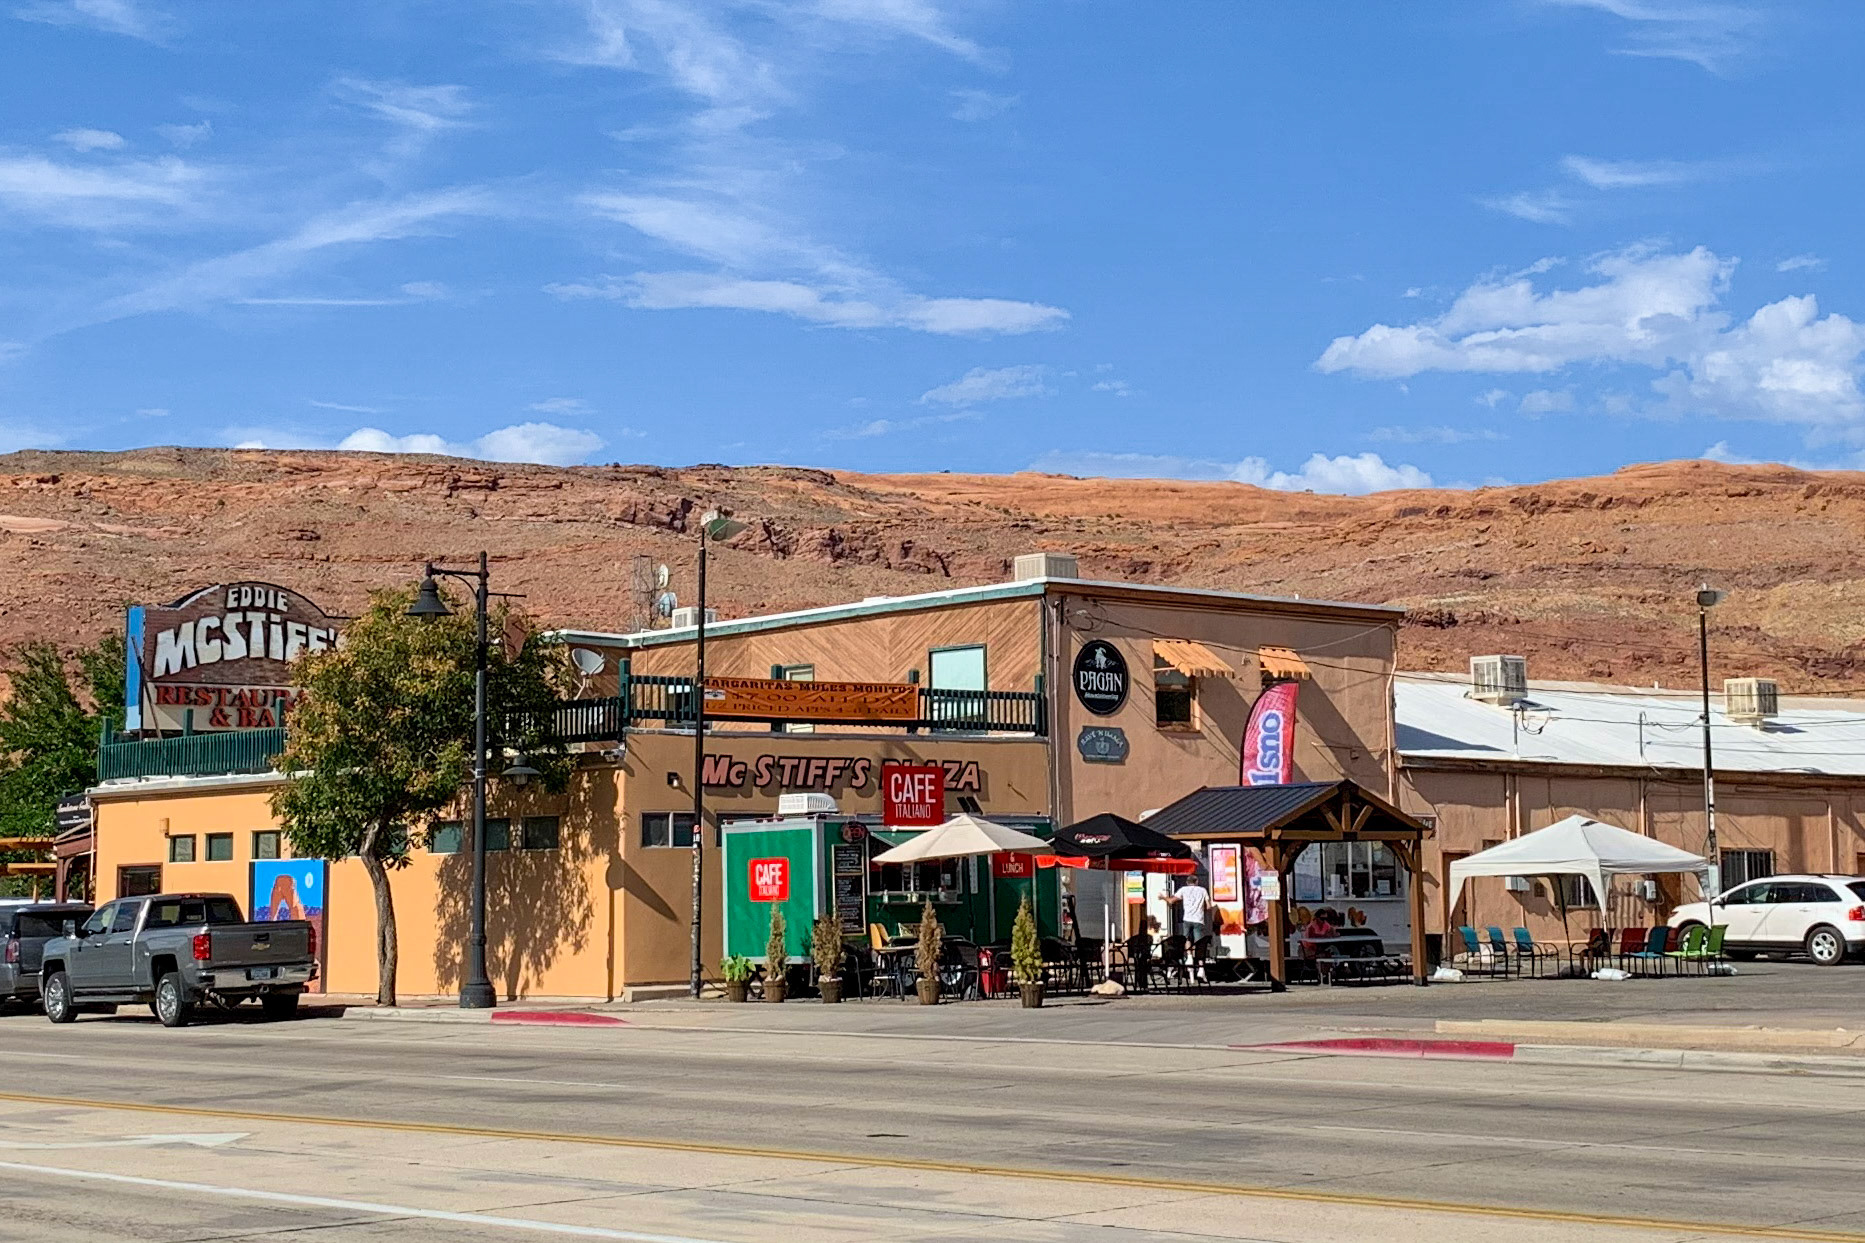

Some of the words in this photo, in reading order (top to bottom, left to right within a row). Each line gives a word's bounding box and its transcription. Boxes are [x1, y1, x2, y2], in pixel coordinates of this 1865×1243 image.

[226, 586, 288, 612] EDDIE
[799, 682, 847, 692] MULES
[1080, 671, 1122, 691] PAGAN
[863, 697, 913, 705] DAY
[209, 708, 231, 727] &
[890, 773, 937, 804] CAFE
[894, 804, 931, 819] ITALIANO
[755, 863, 783, 885] CAFE
[1002, 862, 1023, 874] LUNCH
